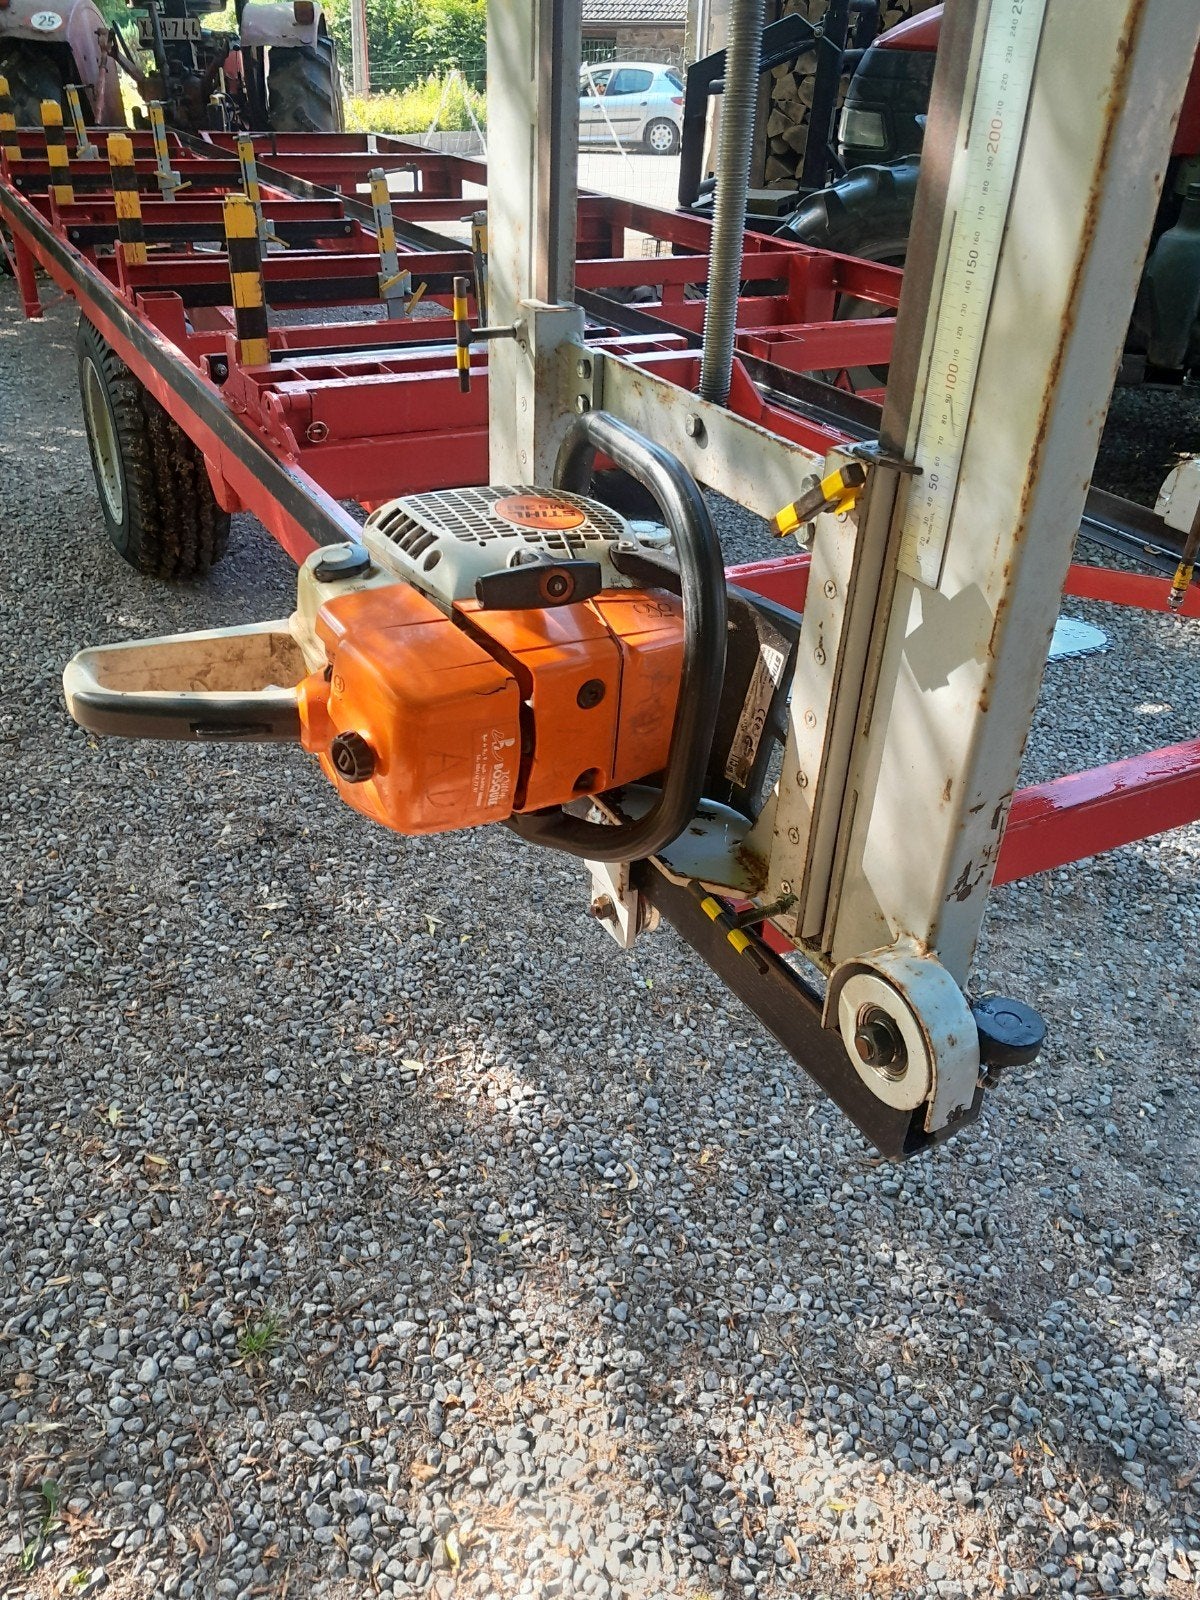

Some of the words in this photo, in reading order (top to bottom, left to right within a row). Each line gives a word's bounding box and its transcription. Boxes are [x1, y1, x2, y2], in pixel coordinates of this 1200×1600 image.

[39, 15, 55, 26] 25
[1010, 19, 1018, 37] 240
[987, 119, 1003, 154] 200
[967, 249, 979, 275] 150
[946, 363, 959, 390] 100
[945, 394, 952, 403] 90
[942, 414, 948, 425] 80
[938, 435, 944, 445] 70
[935, 456, 941, 467] 60
[929, 473, 940, 491] 50
[927, 497, 933, 507] 40
[508, 510, 575, 518] STIHL
[923, 516, 929, 527] 30
[920, 536, 926, 546] 20
